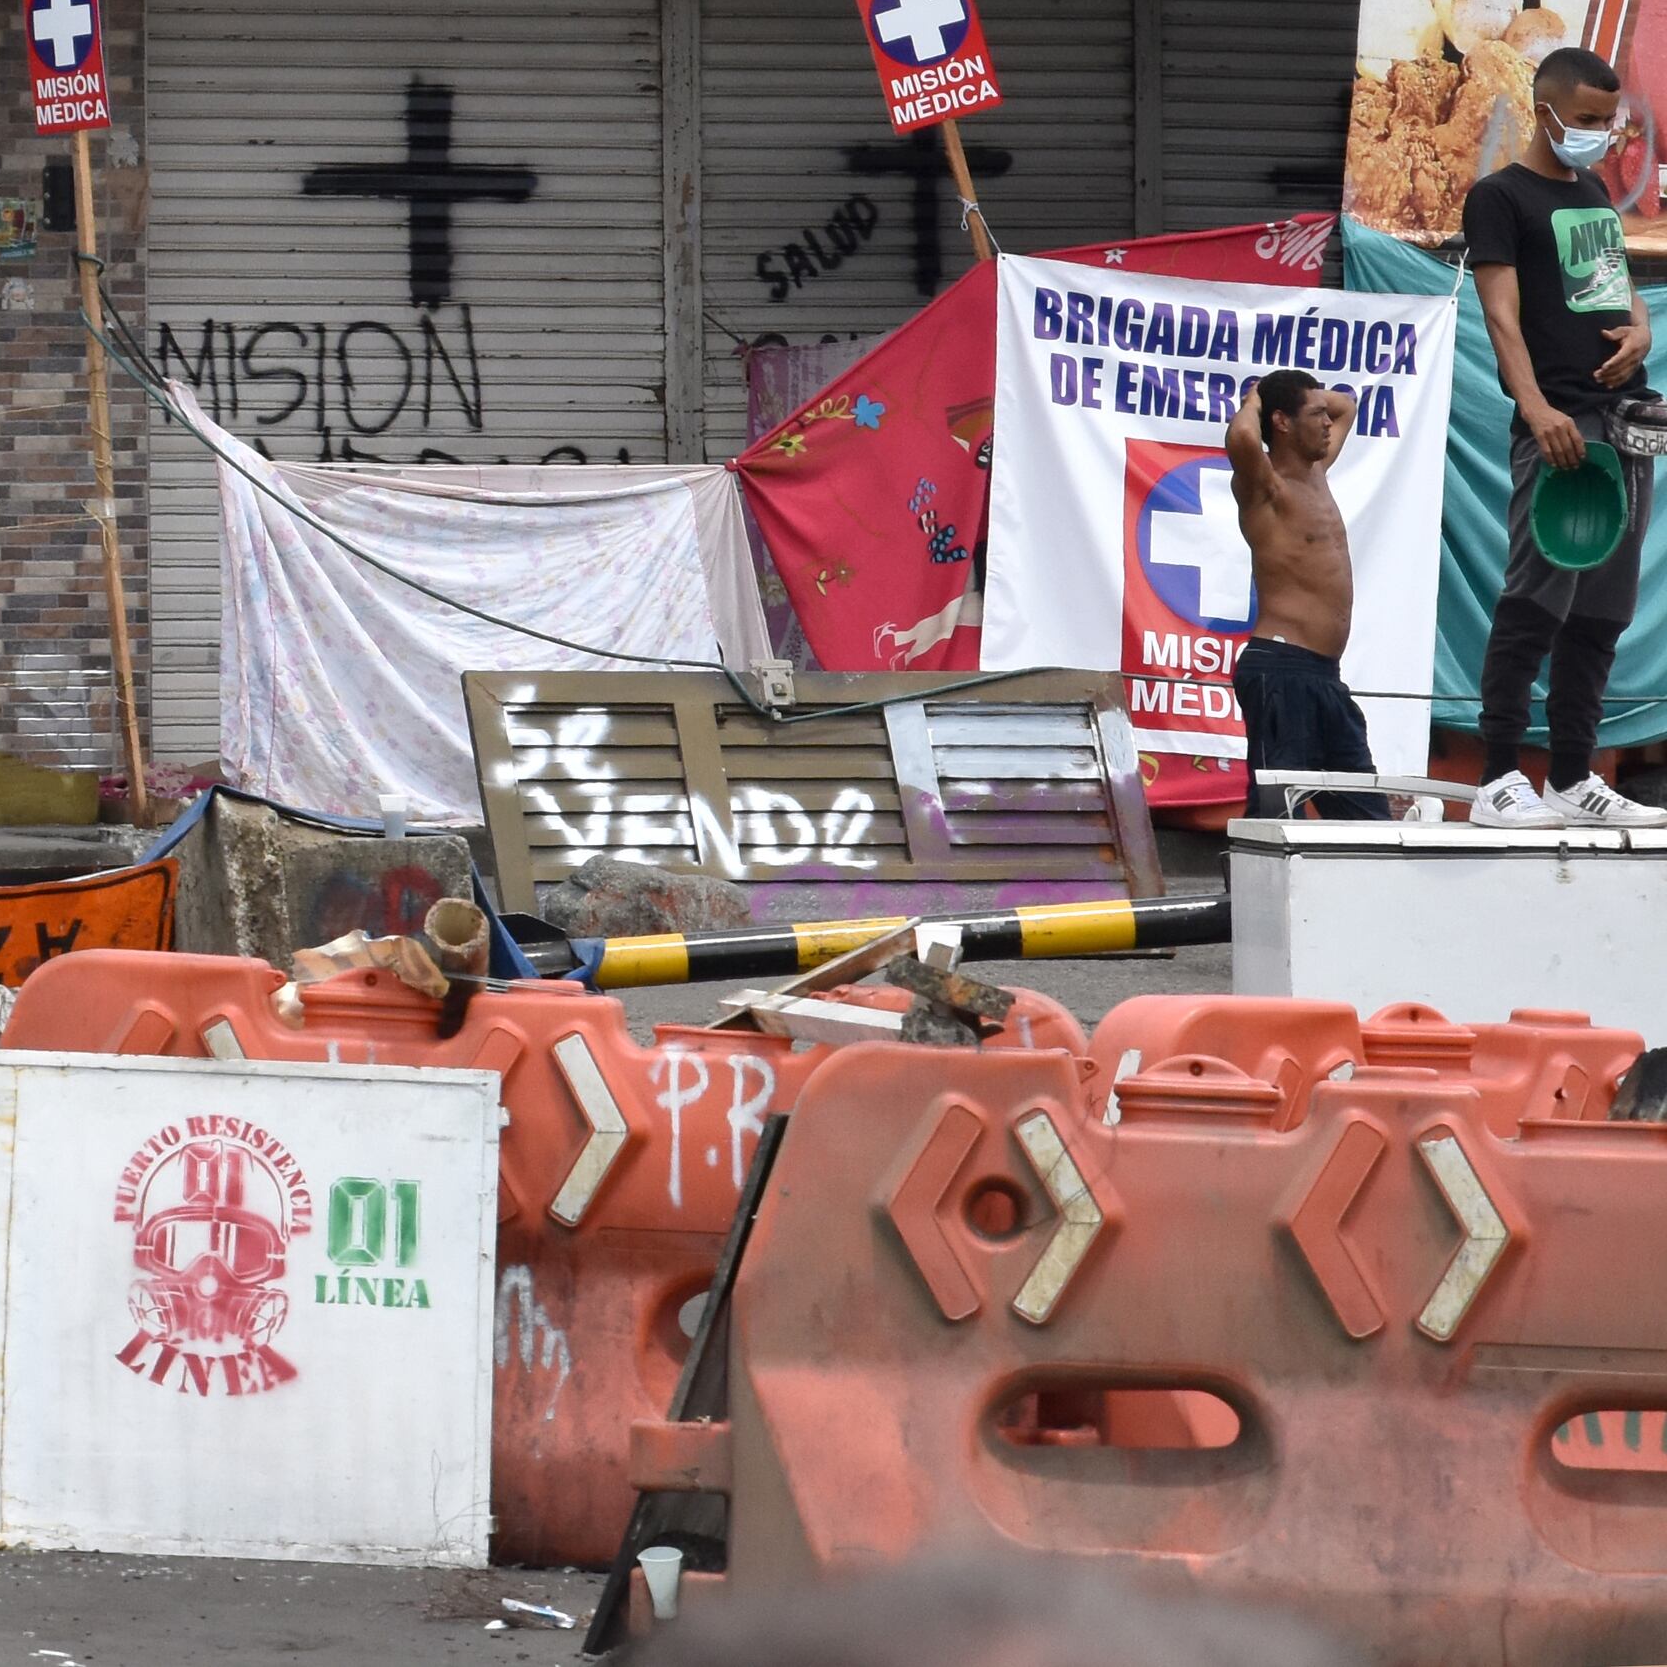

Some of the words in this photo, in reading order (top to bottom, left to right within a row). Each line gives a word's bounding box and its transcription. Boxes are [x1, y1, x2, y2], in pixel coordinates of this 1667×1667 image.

[36, 70, 101, 99] MISIÓN
[891, 55, 986, 99] MISIÓN
[893, 79, 999, 125] MÉDICA
[36, 99, 107, 126] MÉDICA
[1569, 217, 1622, 267] NIKE
[1033, 285, 1240, 364] BRIGADA
[1251, 306, 1418, 376] MÉDICA
[1051, 352, 1104, 410] DE
[1115, 359, 1401, 439] EMERIA
[1143, 629, 1249, 675] MISI
[1131, 672, 1243, 722] MÉDI
[114, 1124, 182, 1223] PUERTO
[185, 1114, 314, 1235] RESISTENCIA
[183, 1142, 244, 1207] 01
[327, 1175, 423, 1268] 01
[314, 1268, 432, 1309] LÍNEA
